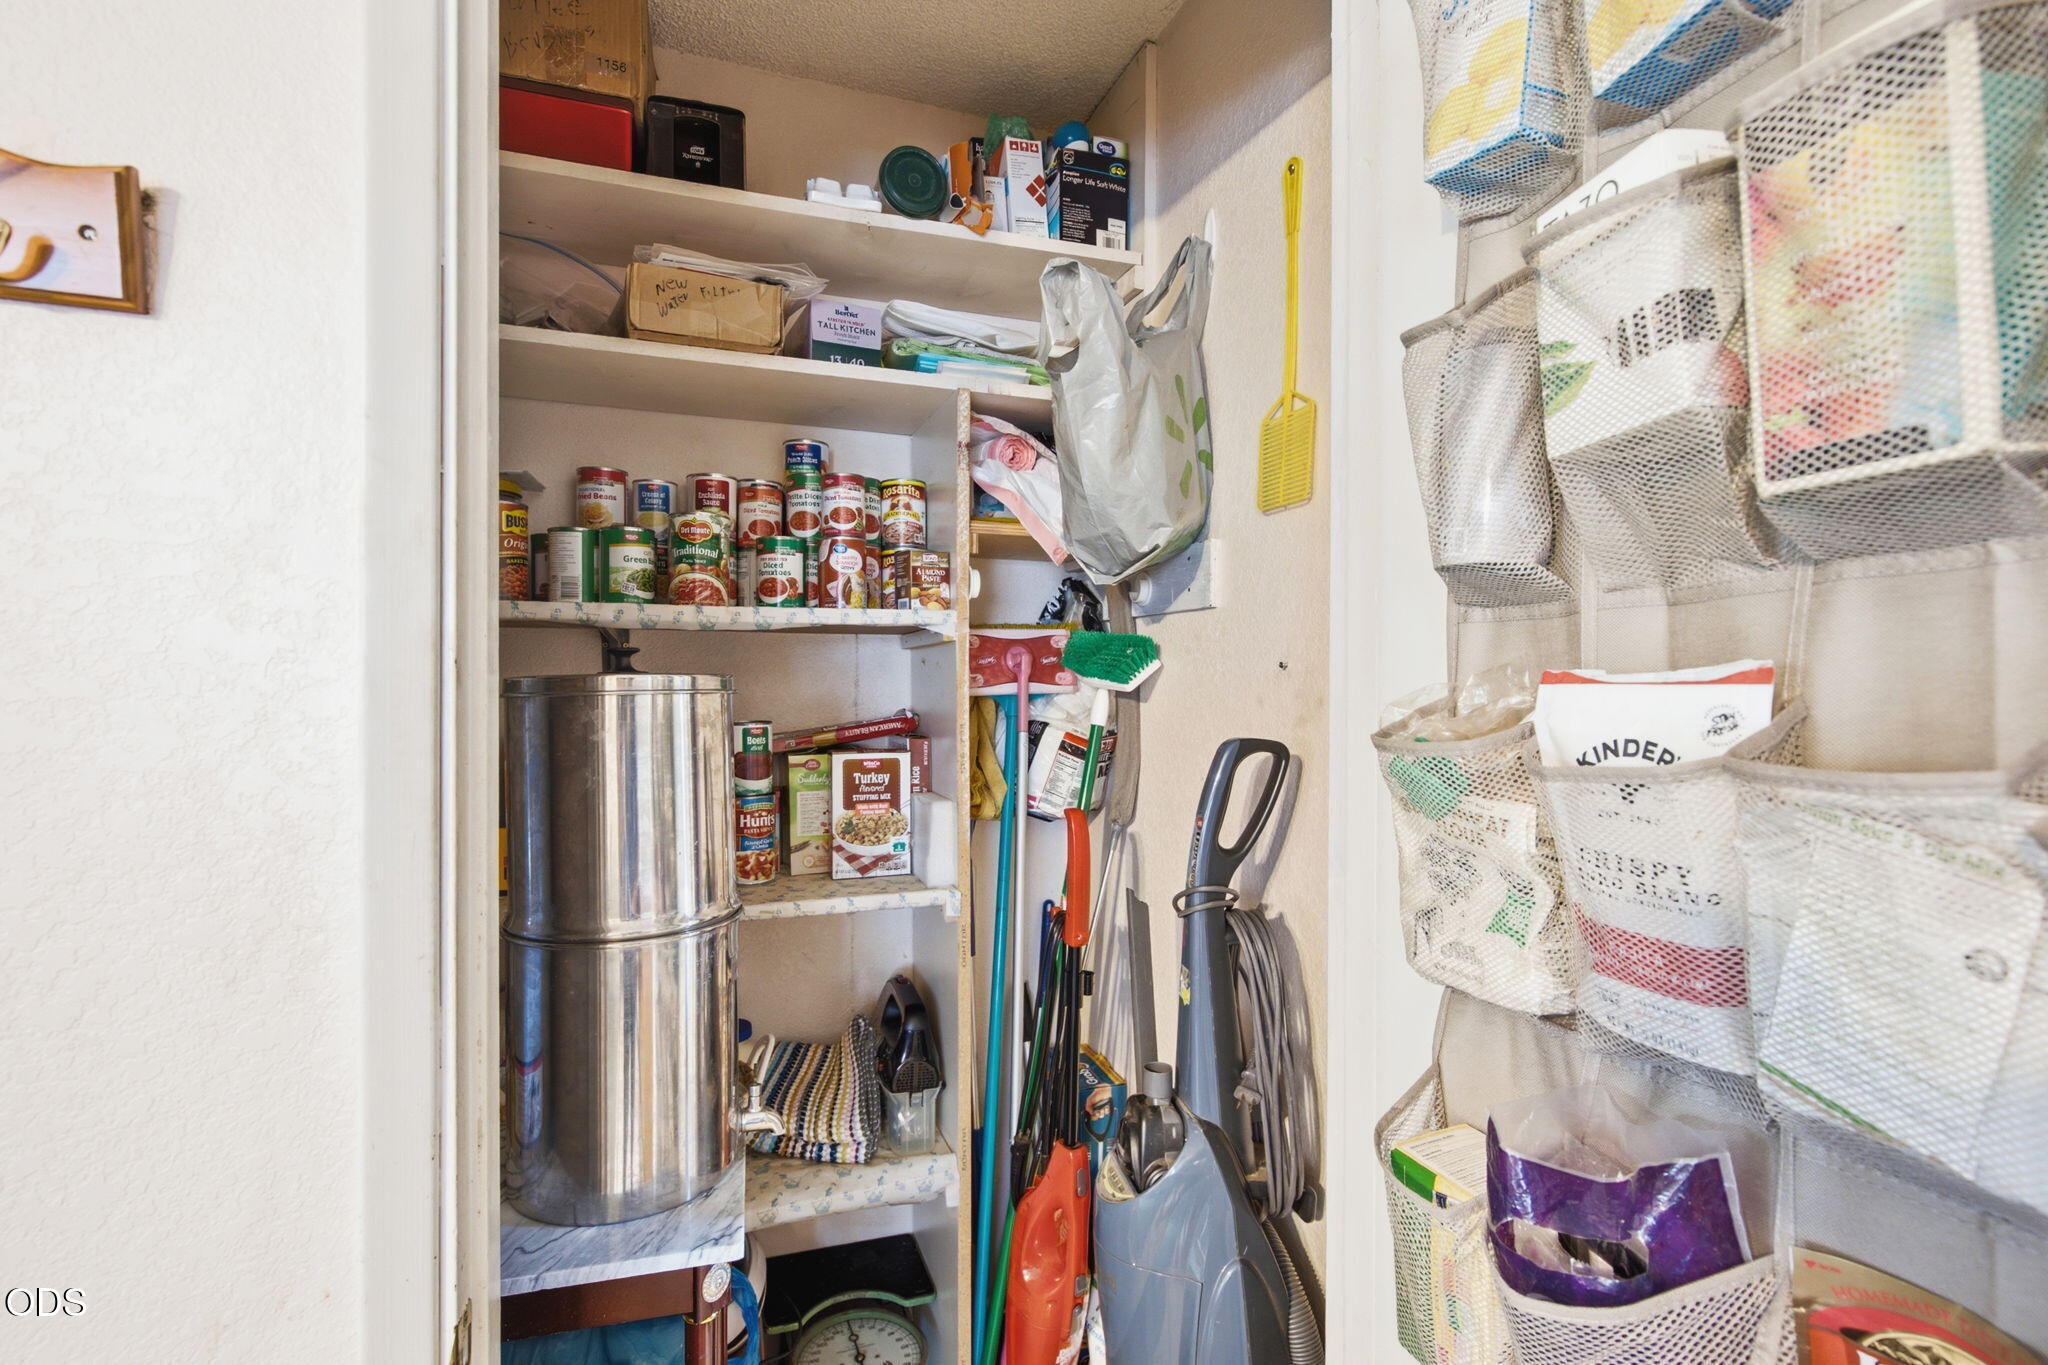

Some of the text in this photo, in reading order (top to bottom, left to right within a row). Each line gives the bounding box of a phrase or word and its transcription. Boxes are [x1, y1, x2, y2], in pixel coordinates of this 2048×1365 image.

[1062, 174, 1084, 185] Longer
[1084, 177, 1096, 187] Life
[1108, 182, 1127, 193] White
[817, 320, 876, 337] TALL KITCHEN
[593, 492, 617, 501] Beans
[697, 492, 726, 500] Enchilada
[702, 499, 720, 507] Sauce
[506, 513, 528, 529] BUS
[691, 527, 710, 535] Monte
[504, 538, 528, 550] Orig
[673, 544, 719, 559] Traditional
[623, 555, 649, 564] Green
[763, 561, 784, 569] Diced
[758, 569, 792, 577] Tomatoes
[915, 568, 946, 577] ALMOND
[921, 575, 941, 583] PASTE
[746, 735, 767, 745] Beets
[853, 772, 891, 785] Turkey
[911, 766, 921, 785] Rice
[852, 794, 879, 802] STUFFING
